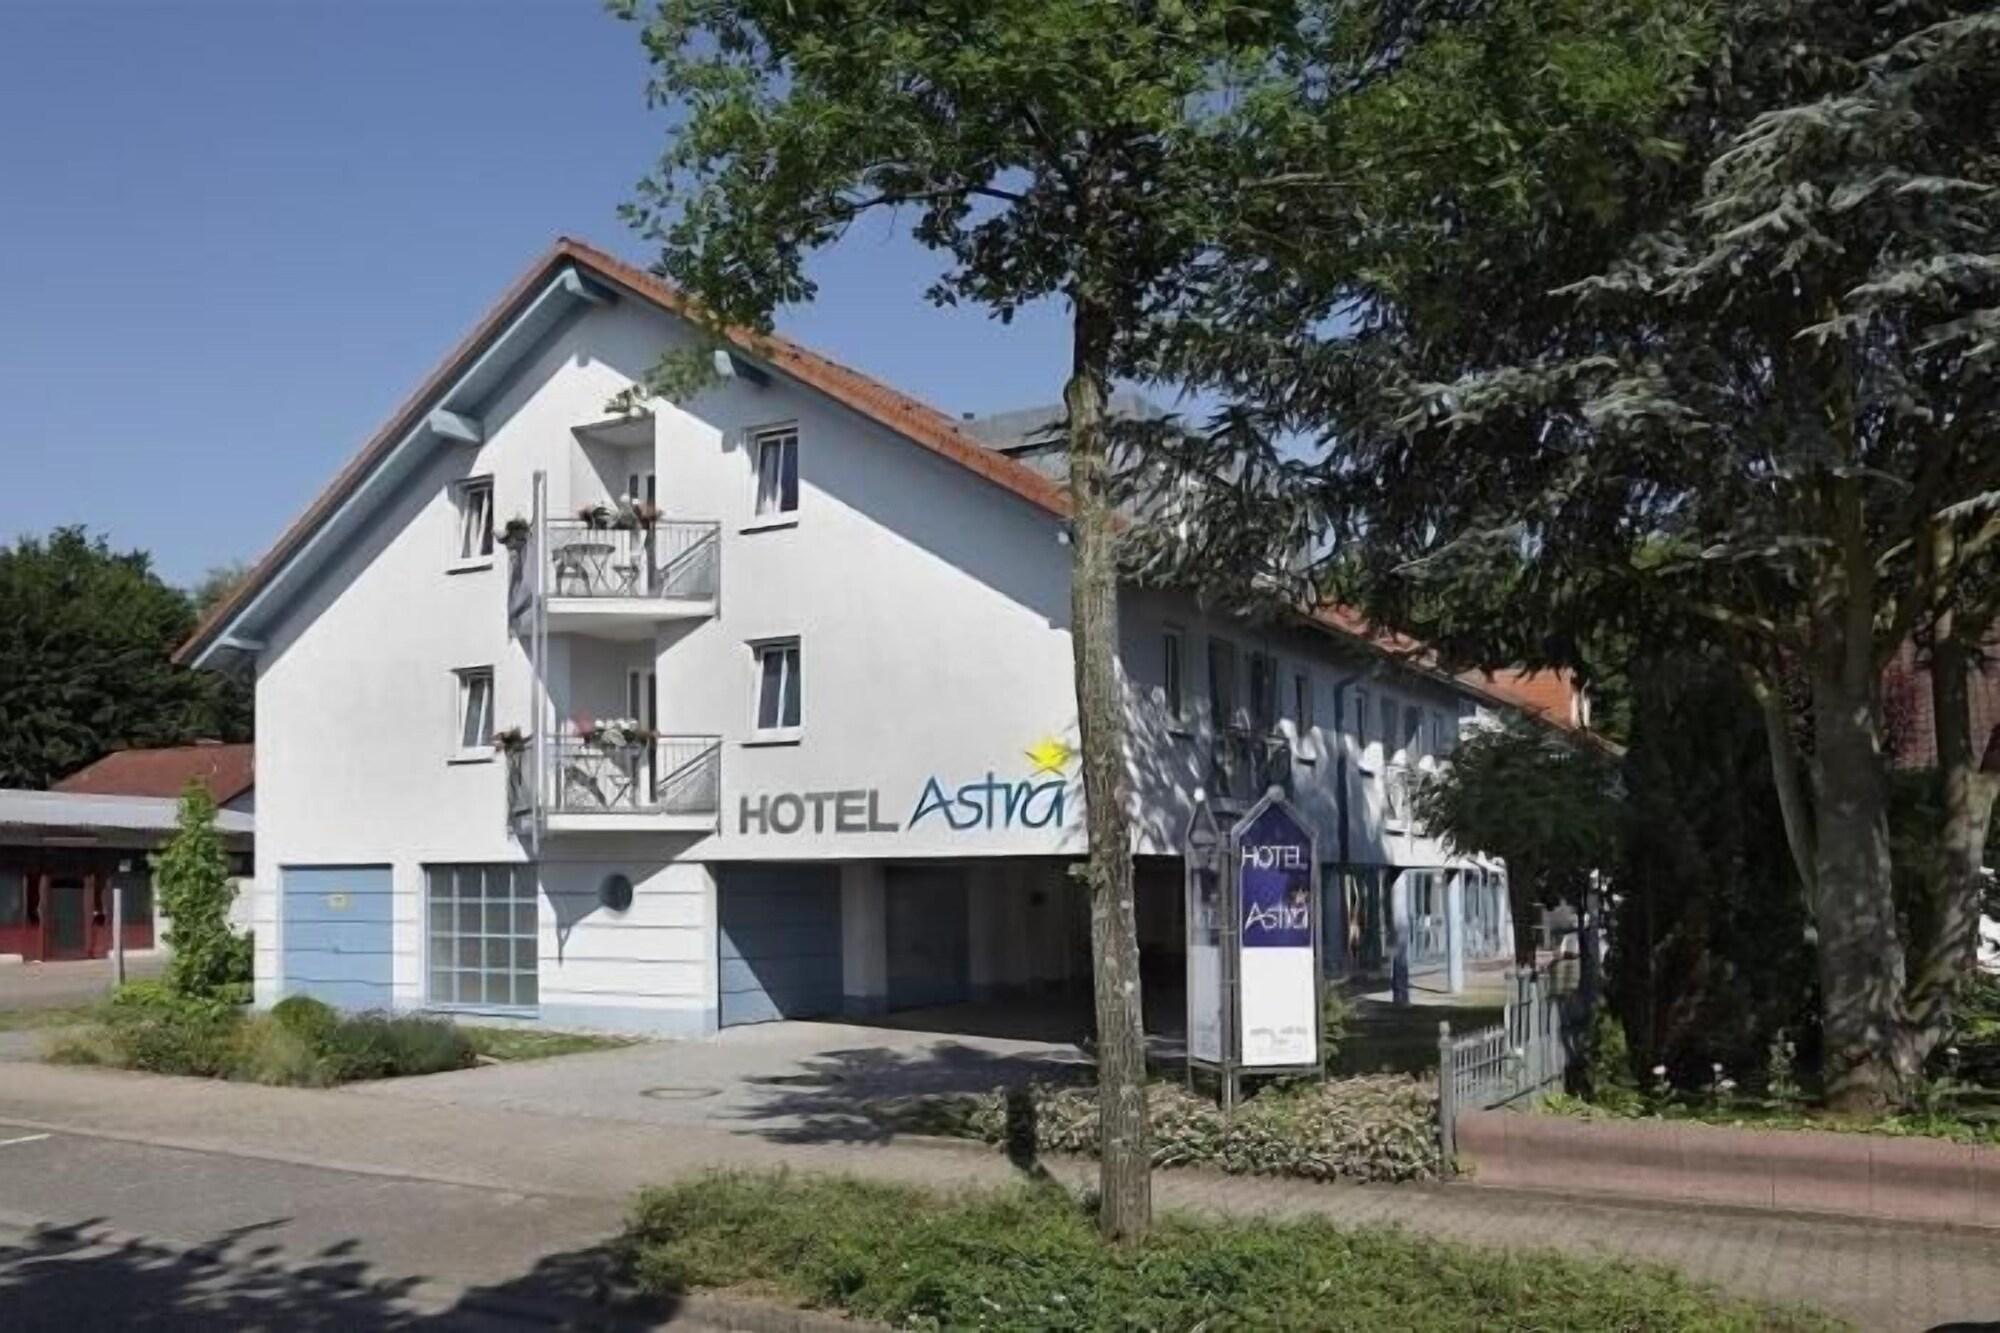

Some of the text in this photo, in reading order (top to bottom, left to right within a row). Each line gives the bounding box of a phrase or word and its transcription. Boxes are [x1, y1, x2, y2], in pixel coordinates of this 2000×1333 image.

[739, 771, 1067, 835] HOTEL Astra
[1241, 845, 1308, 870] HOTEL
[1244, 902, 1309, 932] Astra
